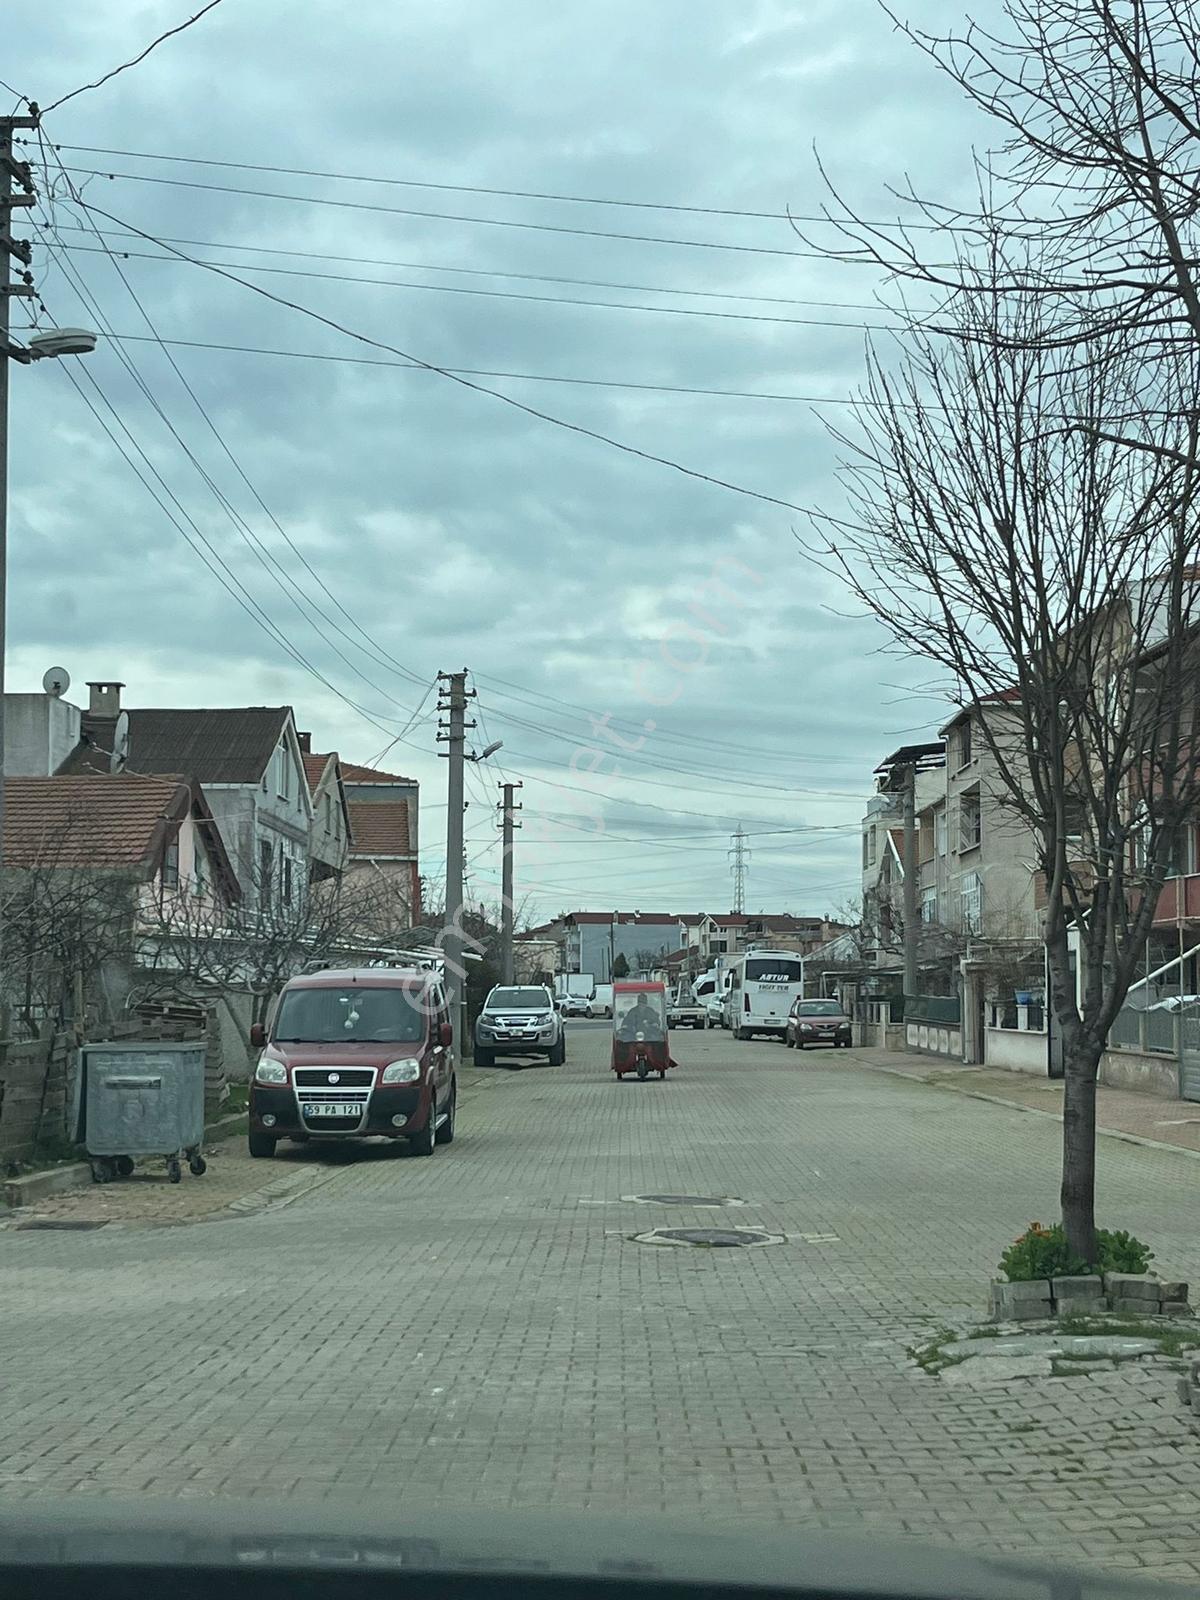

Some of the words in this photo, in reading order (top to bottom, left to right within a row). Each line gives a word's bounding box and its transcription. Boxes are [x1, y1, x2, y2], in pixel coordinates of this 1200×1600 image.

[308, 1105, 320, 1115] 59
[325, 1105, 336, 1115] PA
[344, 1105, 358, 1115] 121
